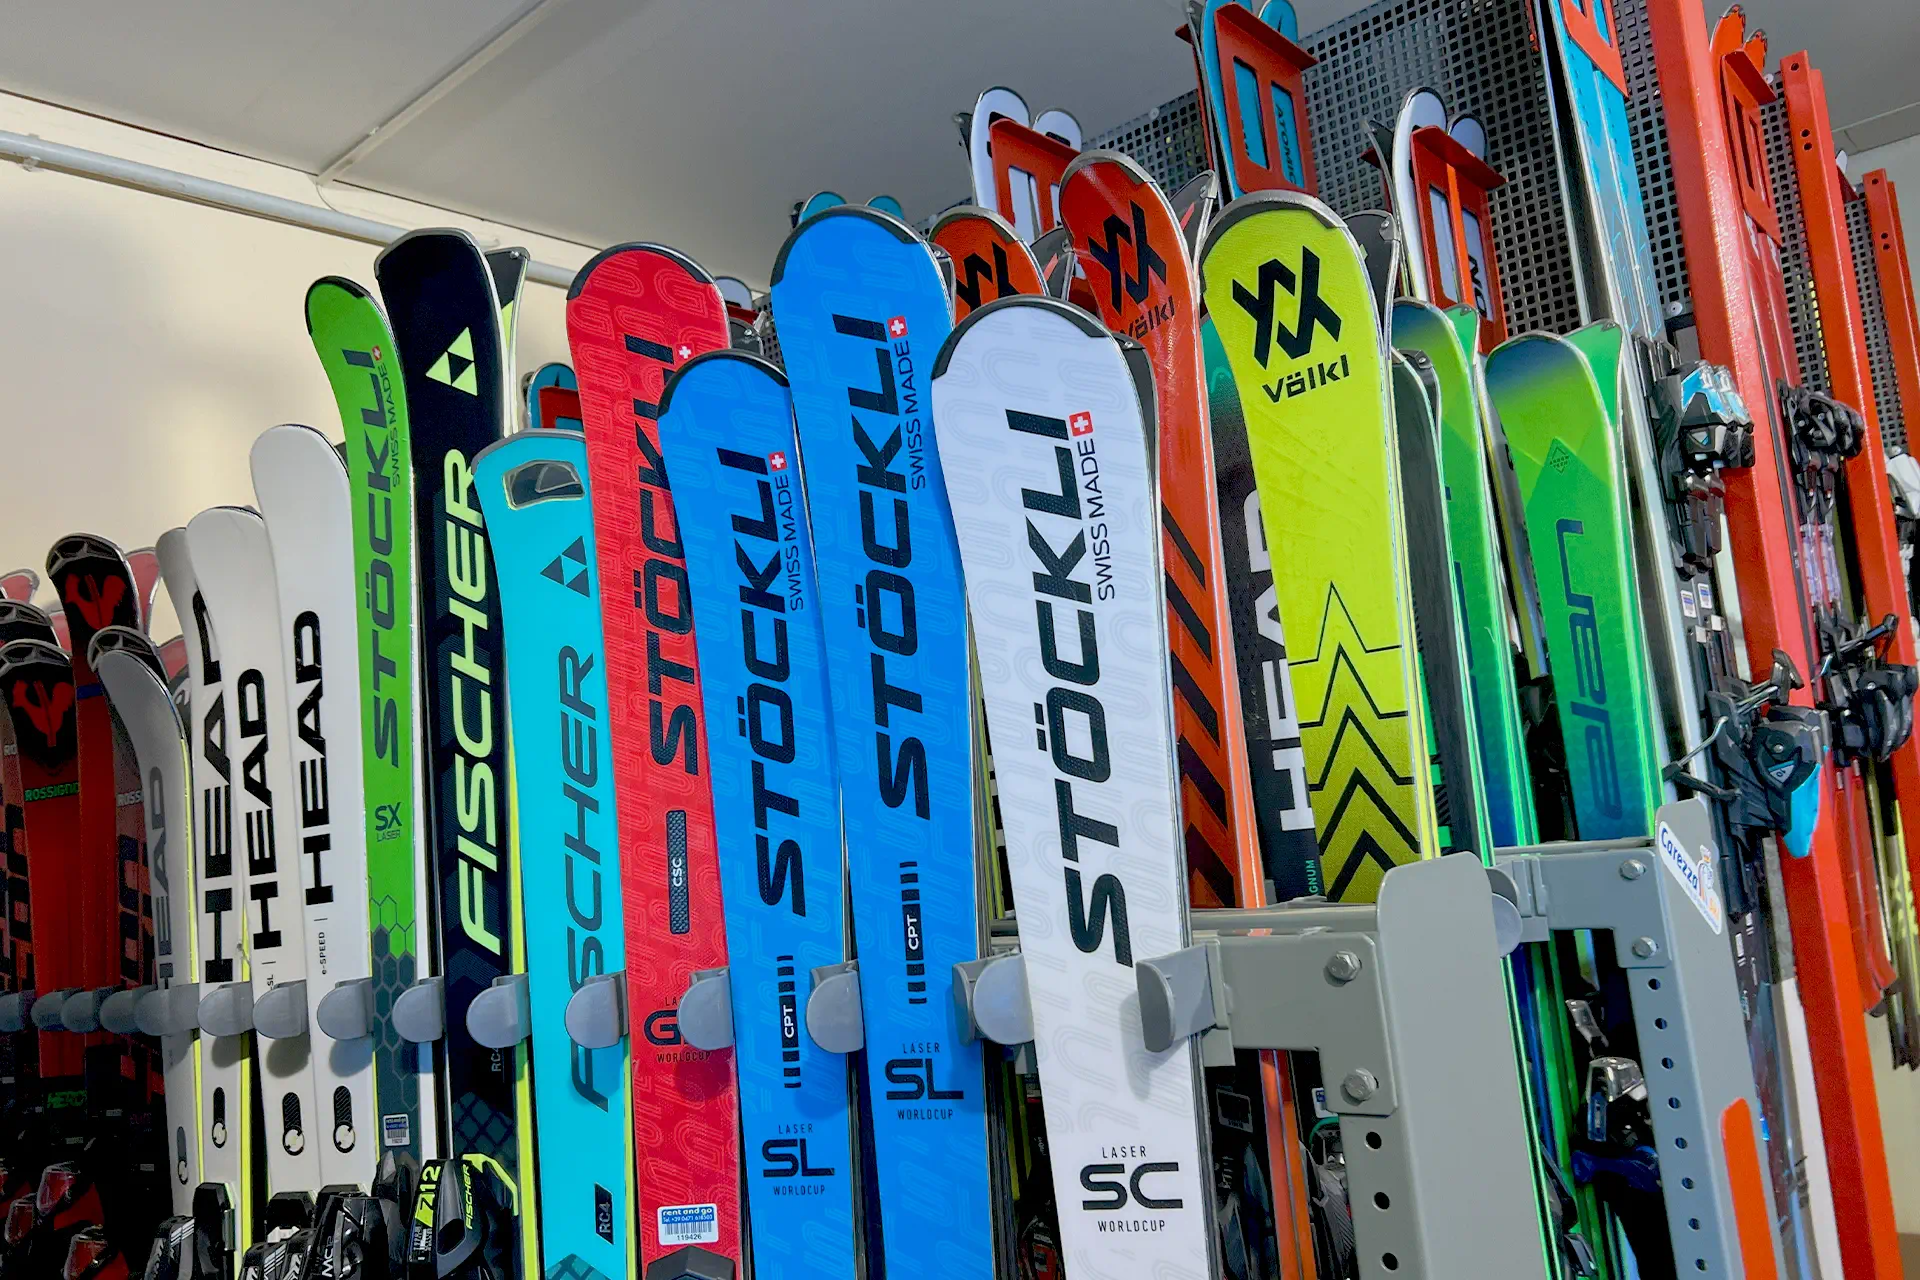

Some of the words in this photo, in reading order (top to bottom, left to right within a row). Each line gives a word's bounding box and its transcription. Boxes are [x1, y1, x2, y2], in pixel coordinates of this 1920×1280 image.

[378, 364, 398, 427] MADE
[894, 340, 919, 413] MADE
[1262, 354, 1350, 404] Völkl
[390, 428, 401, 488] SWISS
[906, 419, 926, 490] SWISS
[1077, 438, 1105, 520] MADE
[776, 473, 797, 545] MADE
[341, 348, 399, 768] STÖCKLI
[785, 545, 804, 611] SWISS
[832, 314, 930, 820] STÖCKLI
[1092, 522, 1115, 601] SWISS
[444, 449, 501, 956] FISCHER
[716, 447, 806, 917] STÖCKLI
[1005, 408, 1133, 969] STÖCKLI
[294, 611, 334, 906] HEAD
[237, 668, 282, 950] HEAD
[375, 802, 402, 831] SX
[376, 829, 402, 842] LASER
[1660, 827, 1698, 890] Carezza
[558, 645, 609, 1113] FSCHER
[673, 857, 683, 887] CSC
[1306, 859, 1319, 893] GNUM
[319, 931, 327, 975] e-SPEED
[908, 914, 919, 950] CPT
[644, 1009, 690, 1046] G
[783, 1004, 795, 1038] CPT
[656, 1051, 712, 1063] WORLDCUP
[902, 1042, 940, 1054] LASER
[885, 1058, 964, 1100] SL
[778, 1124, 814, 1135] LASER
[897, 1109, 954, 1121] WORLDCUP
[762, 1138, 835, 1178] SL
[1102, 1145, 1148, 1159] LASER
[462, 1163, 474, 1230] FISCHER
[773, 1184, 826, 1196] WORLDCUP
[1079, 1161, 1183, 1211] SC
[599, 1202, 612, 1234] RC4
[662, 1209, 682, 1217] rent
[682, 1207, 700, 1215] and
[700, 1207, 713, 1216] go
[1097, 1219, 1167, 1233] WORLDCUP
